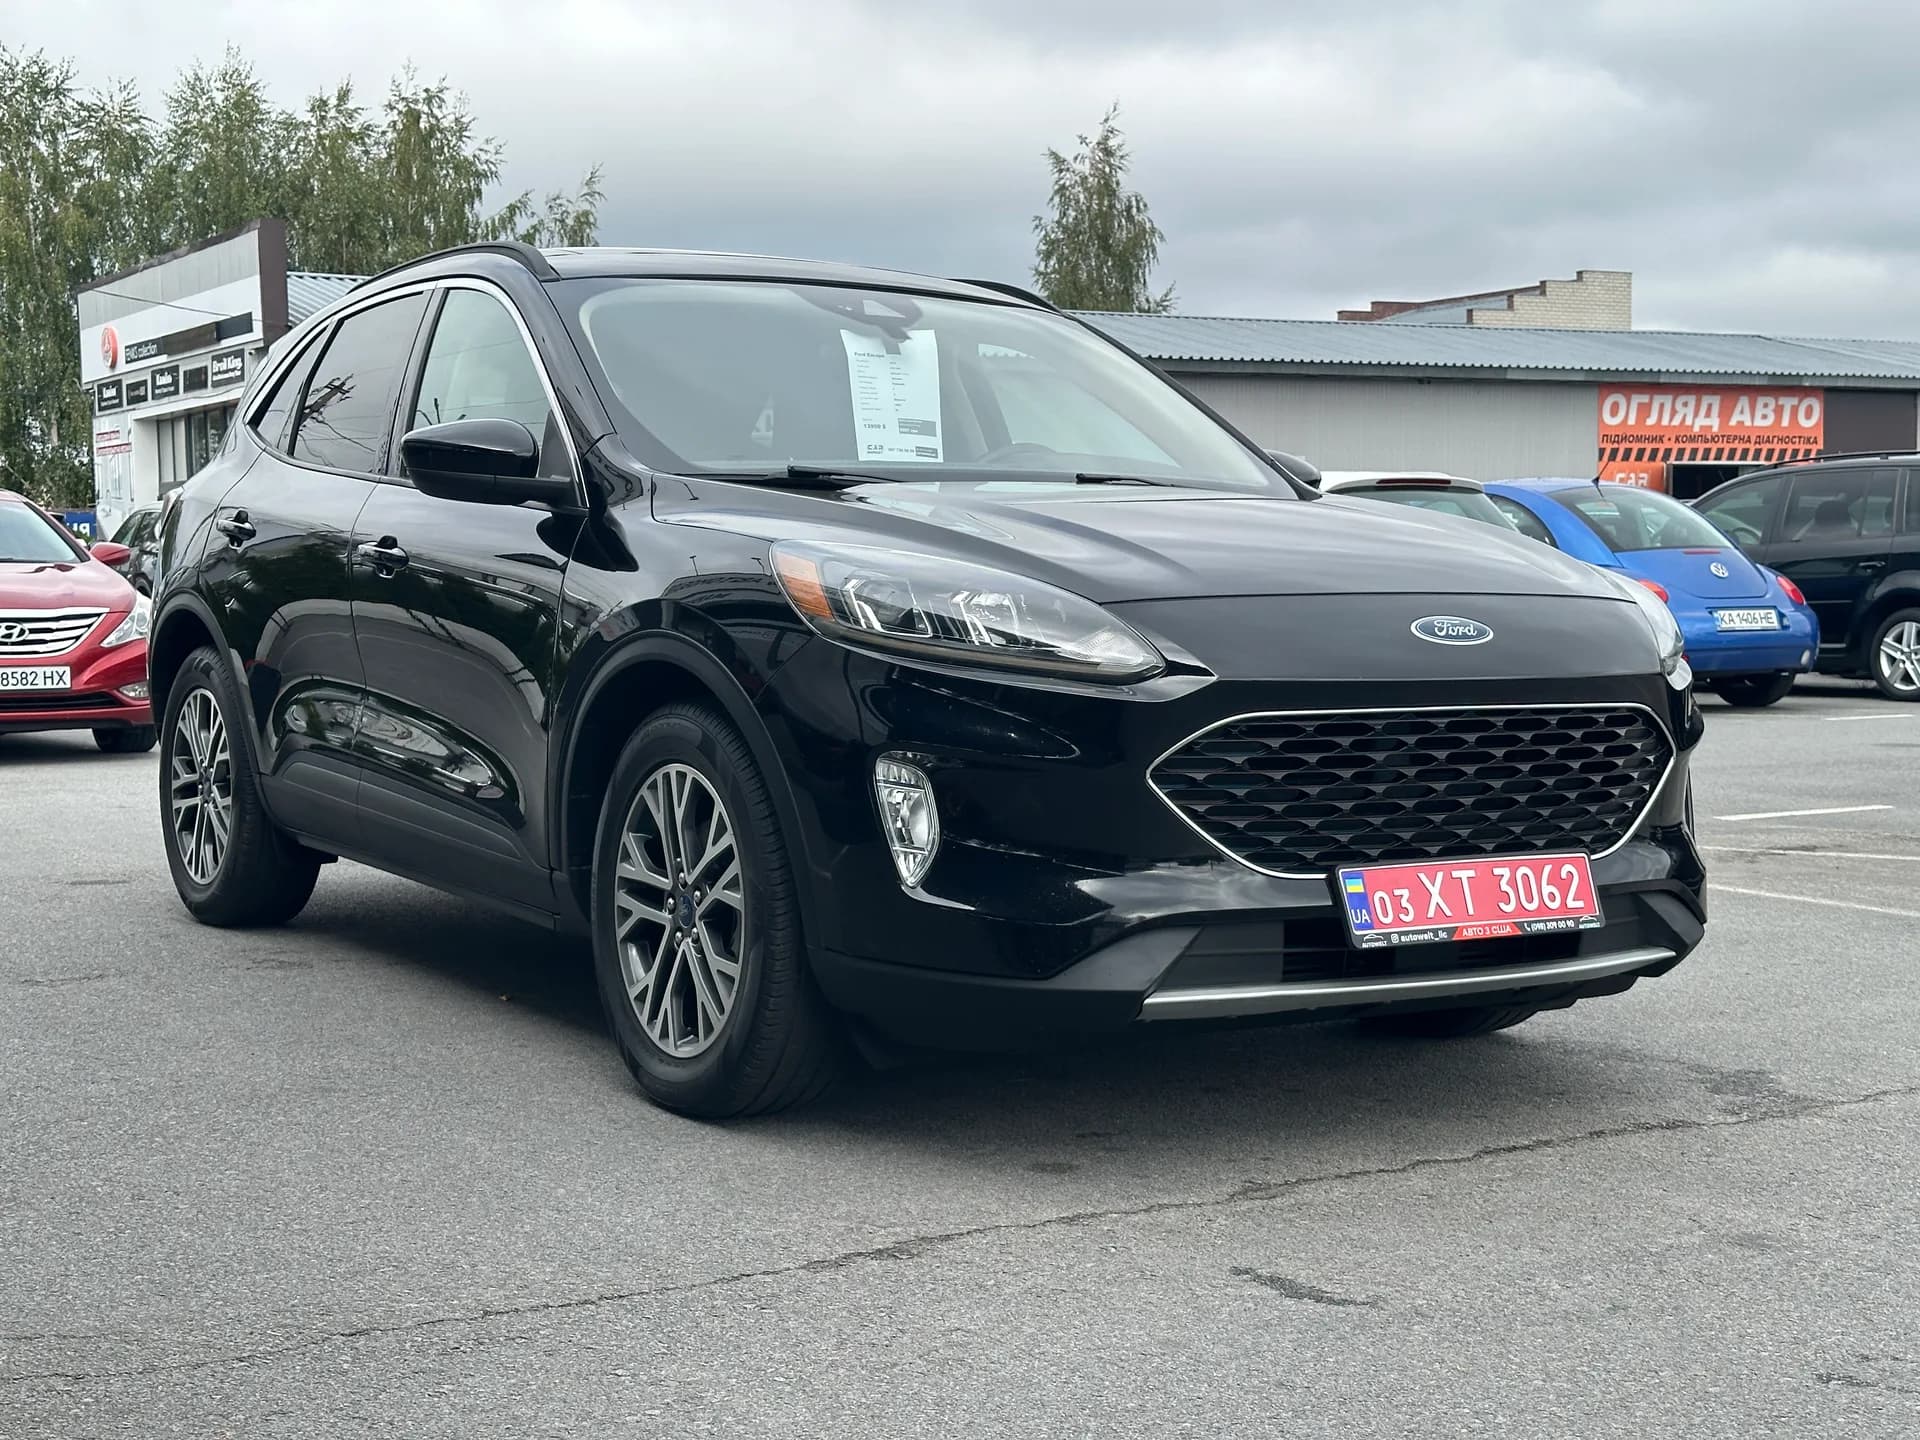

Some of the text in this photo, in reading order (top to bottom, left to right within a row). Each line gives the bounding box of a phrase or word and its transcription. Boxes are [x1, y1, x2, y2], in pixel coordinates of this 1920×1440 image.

[1602, 393, 1821, 432] ОГЛЯД АВТО
[1601, 434, 1819, 446] ПІДЙОМНИК КОМПЬЮТЕРНА ДІАГНОСТІКА
[1434, 620, 1478, 637] Ford
[0, 670, 67, 687] 8582 HX
[1372, 863, 1585, 925] 03 XT 3062
[1351, 908, 1371, 924] UA
[1401, 930, 1448, 943] autowelt_llc
[1462, 926, 1484, 937] АВТО
[1491, 924, 1513, 935] США
